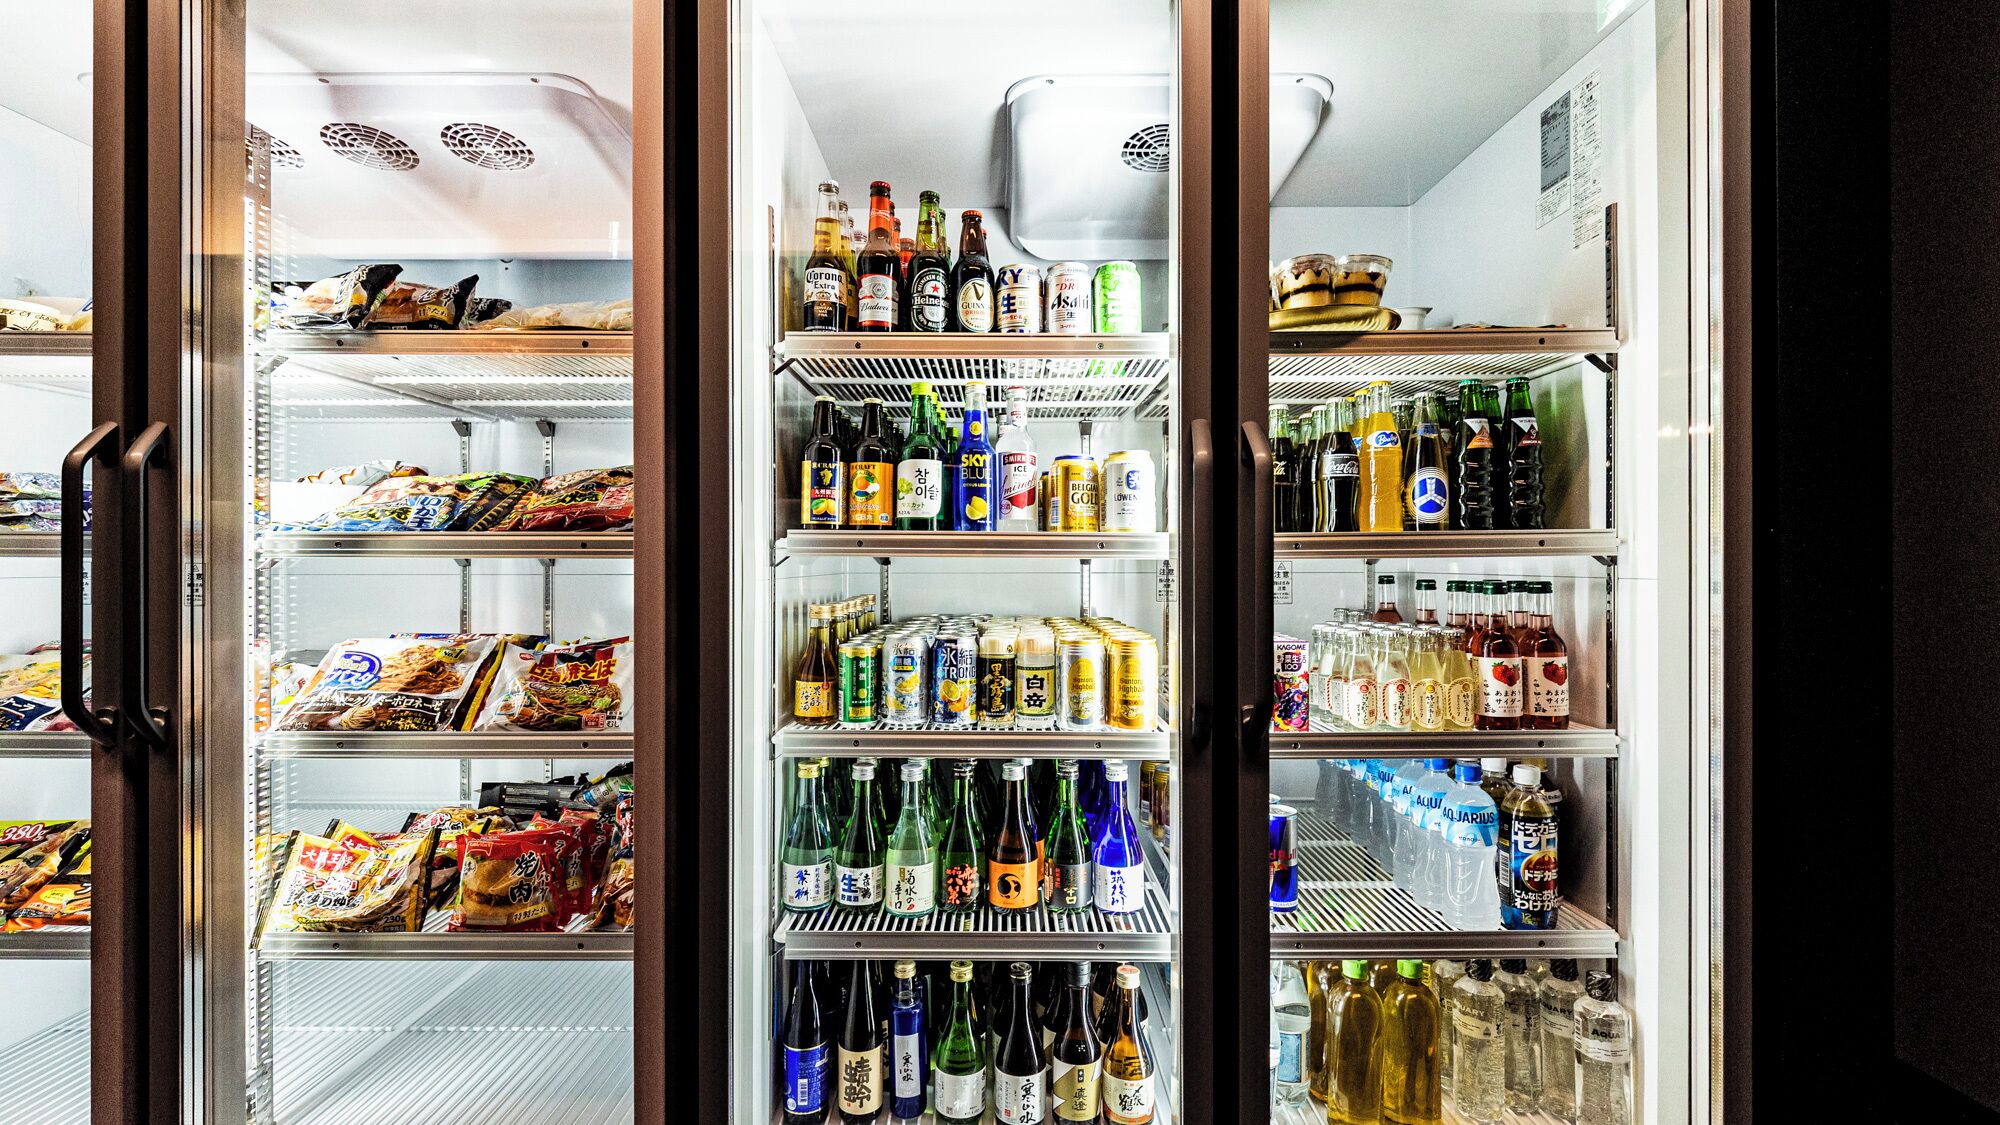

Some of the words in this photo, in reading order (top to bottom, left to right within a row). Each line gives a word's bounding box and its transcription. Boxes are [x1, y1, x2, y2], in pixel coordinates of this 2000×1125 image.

[806, 270, 843, 284] Corona
[814, 280, 836, 290] Extra
[1001, 292, 1017, 315] 生
[1013, 465, 1027, 473] ICE
[1325, 461, 1359, 474] Coca-Cola
[942, 647, 973, 668] 氷結
[1284, 663, 1299, 671] 100
[1023, 674, 1047, 708] 白岳
[1442, 806, 1495, 825] AQUARIUS
[509, 850, 540, 903] 焼肉
[840, 873, 860, 894] 生
[1591, 1028, 1621, 1040] AQUA
